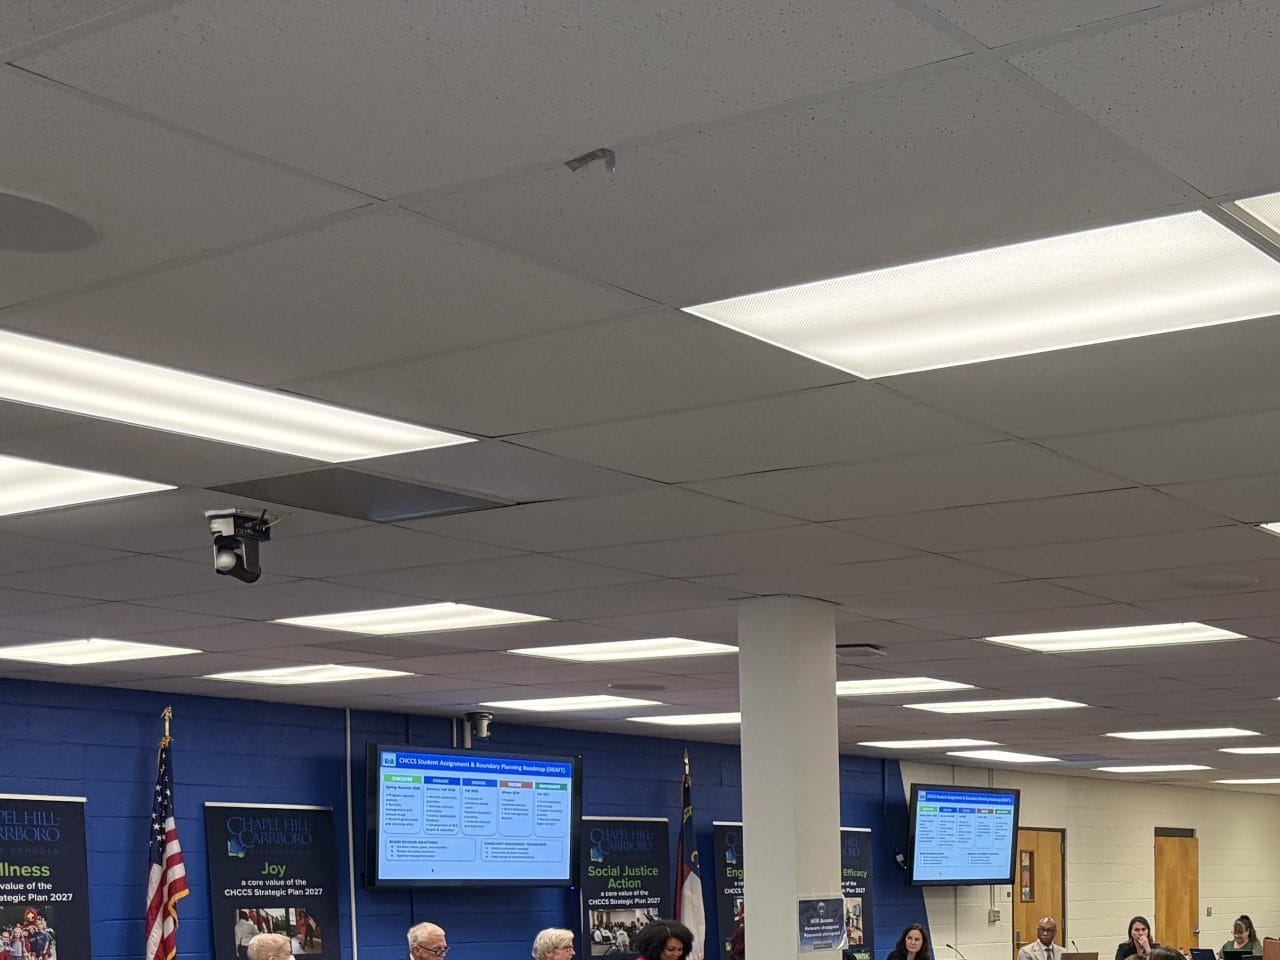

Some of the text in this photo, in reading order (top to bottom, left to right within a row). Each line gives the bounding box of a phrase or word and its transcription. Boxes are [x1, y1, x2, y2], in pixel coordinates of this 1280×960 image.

[418, 758, 438, 766] Student
[440, 760, 469, 769] Assignment
[476, 762, 500, 771] Boundary
[501, 763, 522, 772] Planning
[261, 862, 286, 877] Joy
[588, 865, 659, 877] Social Justice
[843, 868, 868, 879] Efficacy
[27, 881, 36, 890] of
[38, 881, 52, 890] the
[608, 877, 641, 889] Action
[28, 893, 48, 902] Plan
[50, 893, 73, 902] 2027
[254, 888, 286, 897] Strategic
[287, 888, 303, 896] Plan
[305, 888, 323, 896] 2027
